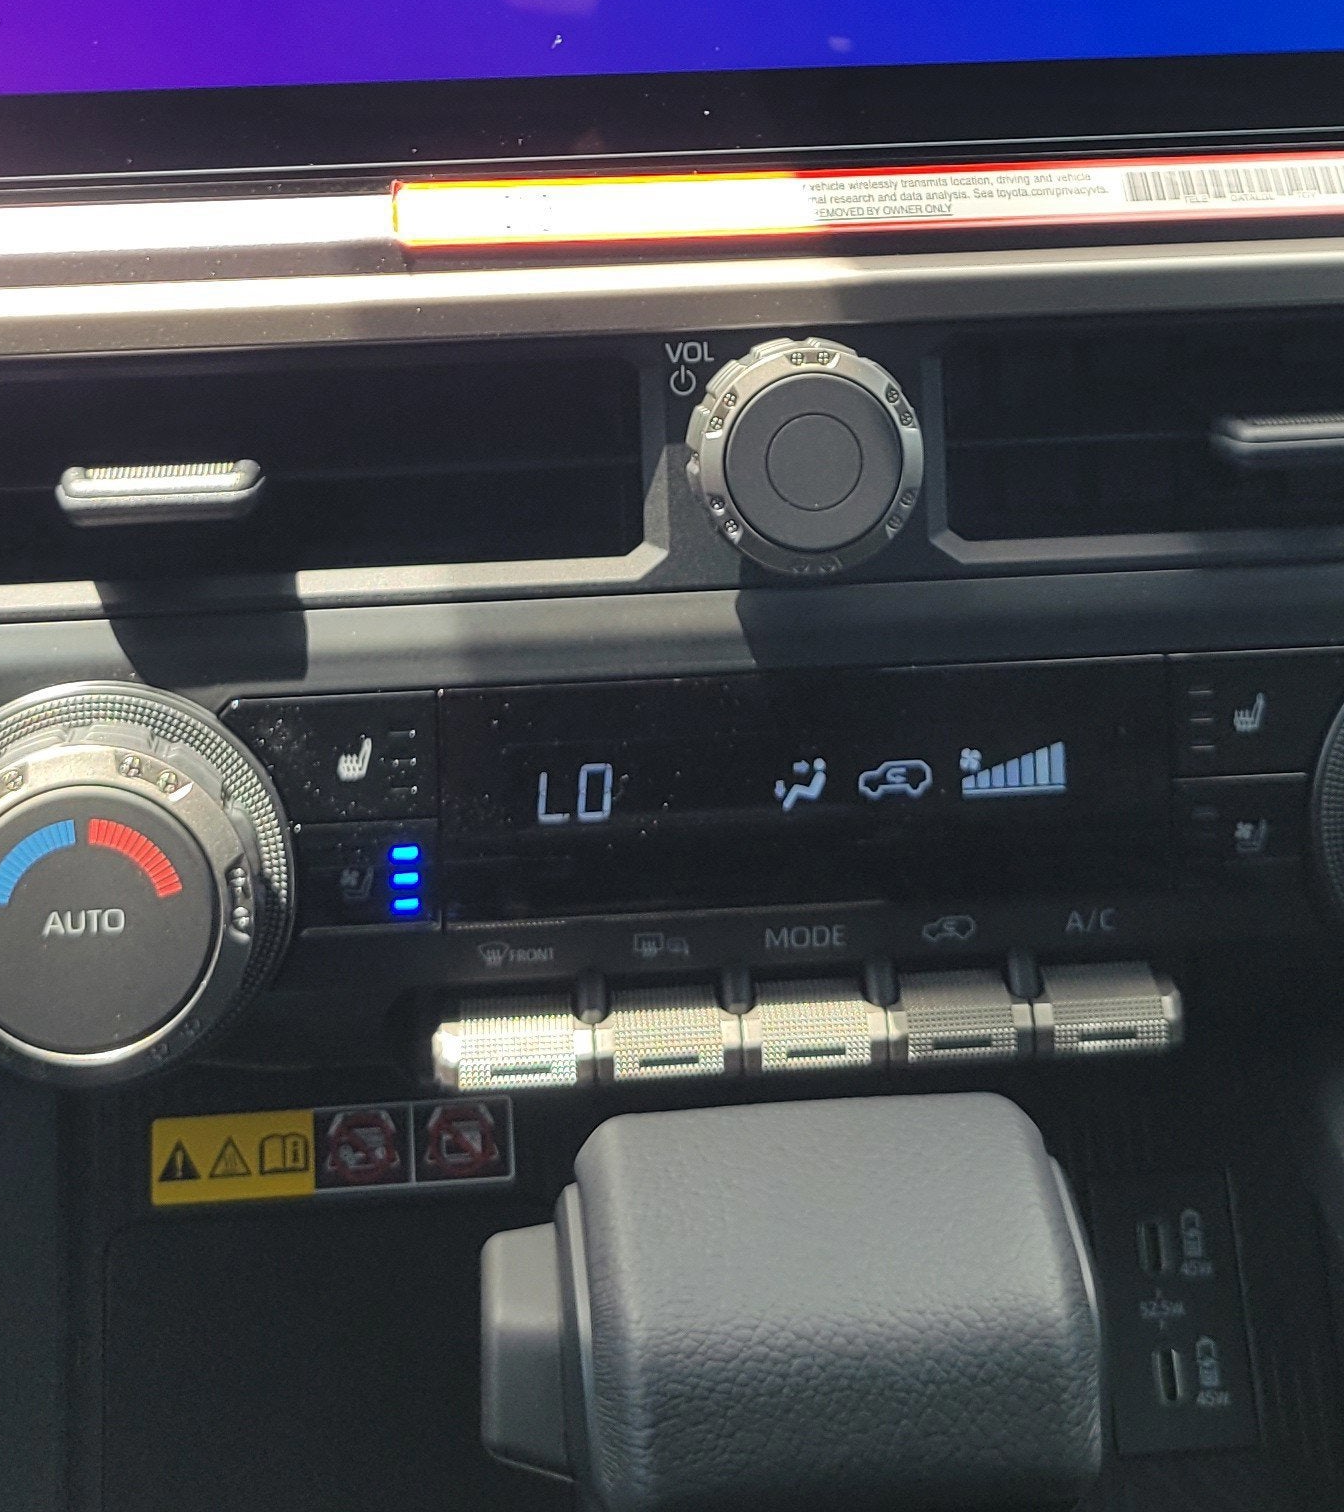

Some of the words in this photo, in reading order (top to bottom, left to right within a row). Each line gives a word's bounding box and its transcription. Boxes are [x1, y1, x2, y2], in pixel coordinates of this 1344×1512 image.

[809, 181, 845, 191] vehicle
[848, 179, 898, 191] wirelessly
[901, 177, 948, 188] transmits
[950, 175, 994, 187] location,
[996, 174, 1031, 186] driving
[1034, 174, 1053, 183] and
[1057, 172, 1091, 183] vehicle
[830, 192, 874, 204] research
[878, 192, 897, 202] and
[900, 191, 922, 202] data
[925, 188, 970, 202] analysis.
[973, 187, 994, 199] See
[866, 206, 880, 216] BY
[883, 204, 922, 216] OWNER
[925, 203, 953, 214] ONLY
[664, 341, 714, 364] VOL
[42, 908, 126, 938] AUTO
[1066, 908, 1118, 933] A/C
[765, 923, 848, 950] MODE
[509, 946, 555, 962] FRONT
